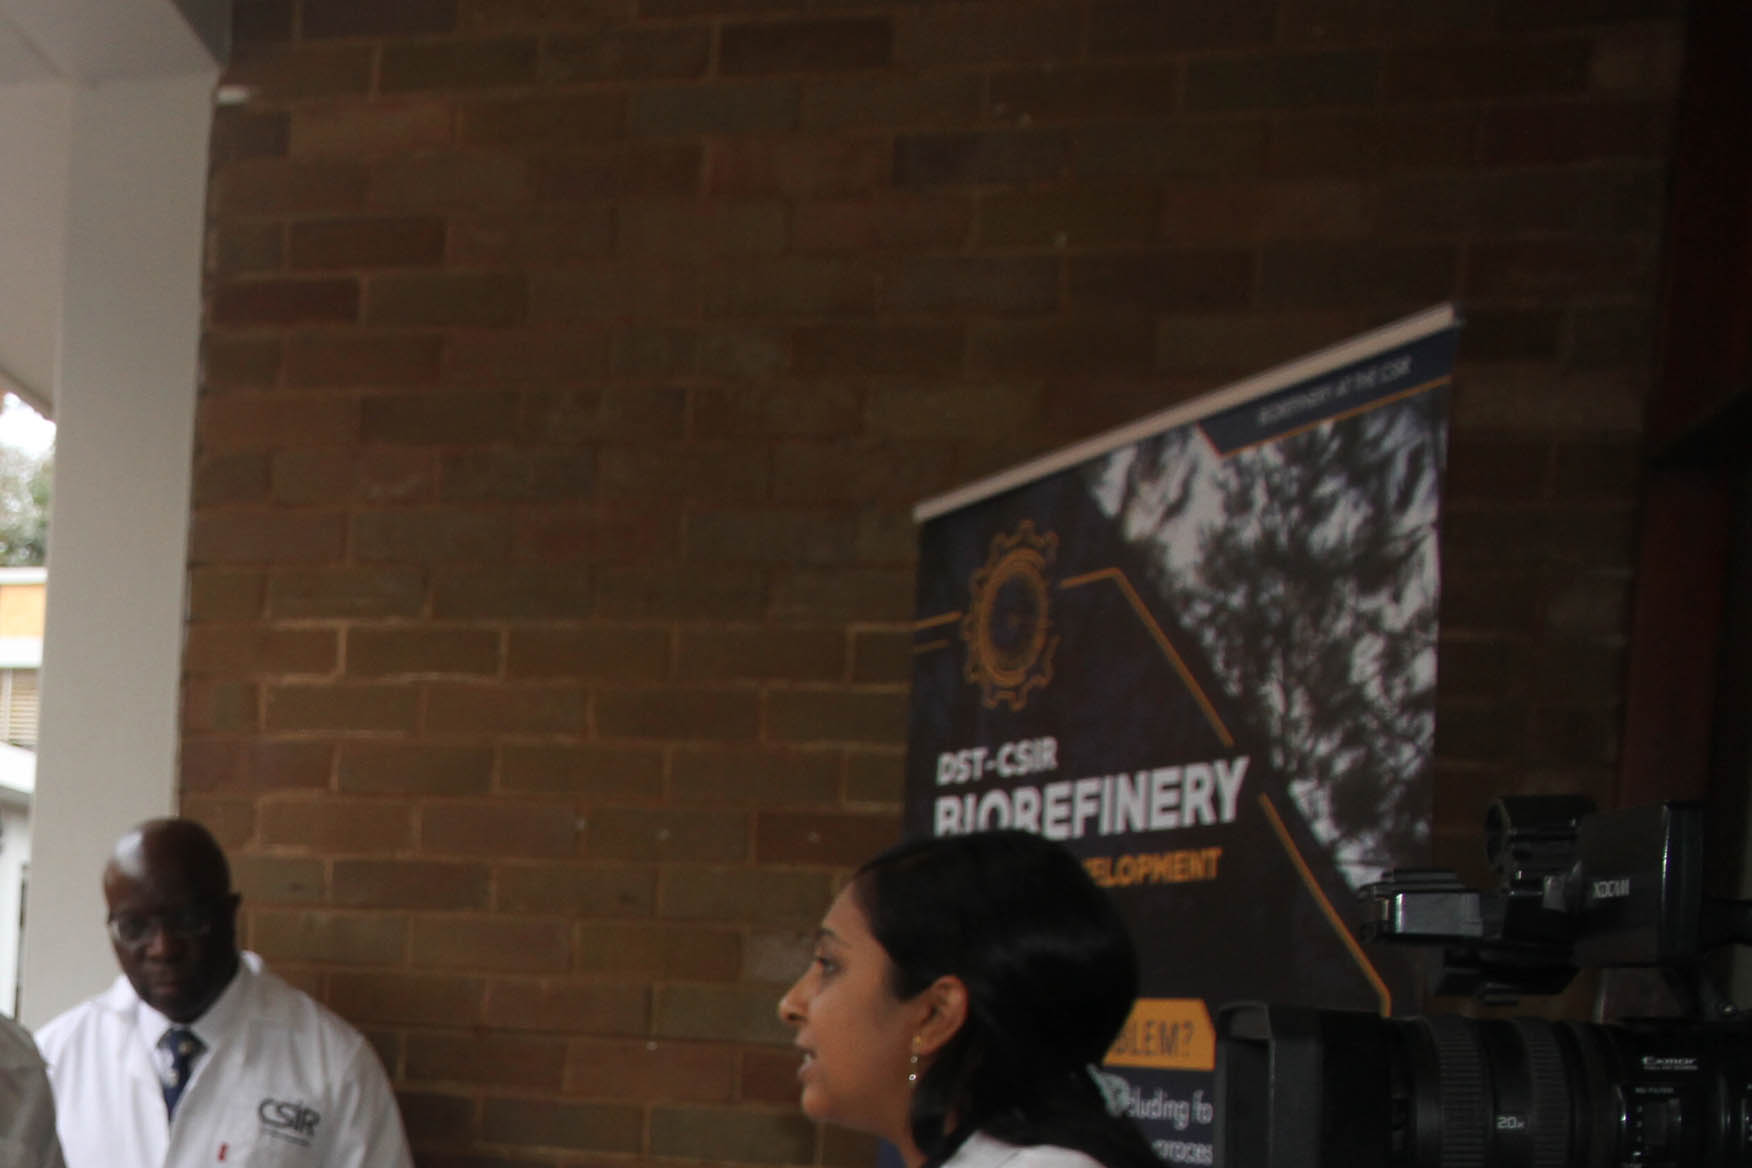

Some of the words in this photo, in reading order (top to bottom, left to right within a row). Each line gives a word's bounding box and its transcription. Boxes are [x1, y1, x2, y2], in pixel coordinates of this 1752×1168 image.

[936, 736, 1059, 786] DST-CSIR
[934, 756, 1249, 840] BIOREFINERY
[1083, 847, 1222, 888] ELOPMENT
[258, 1097, 321, 1137] CSIR
